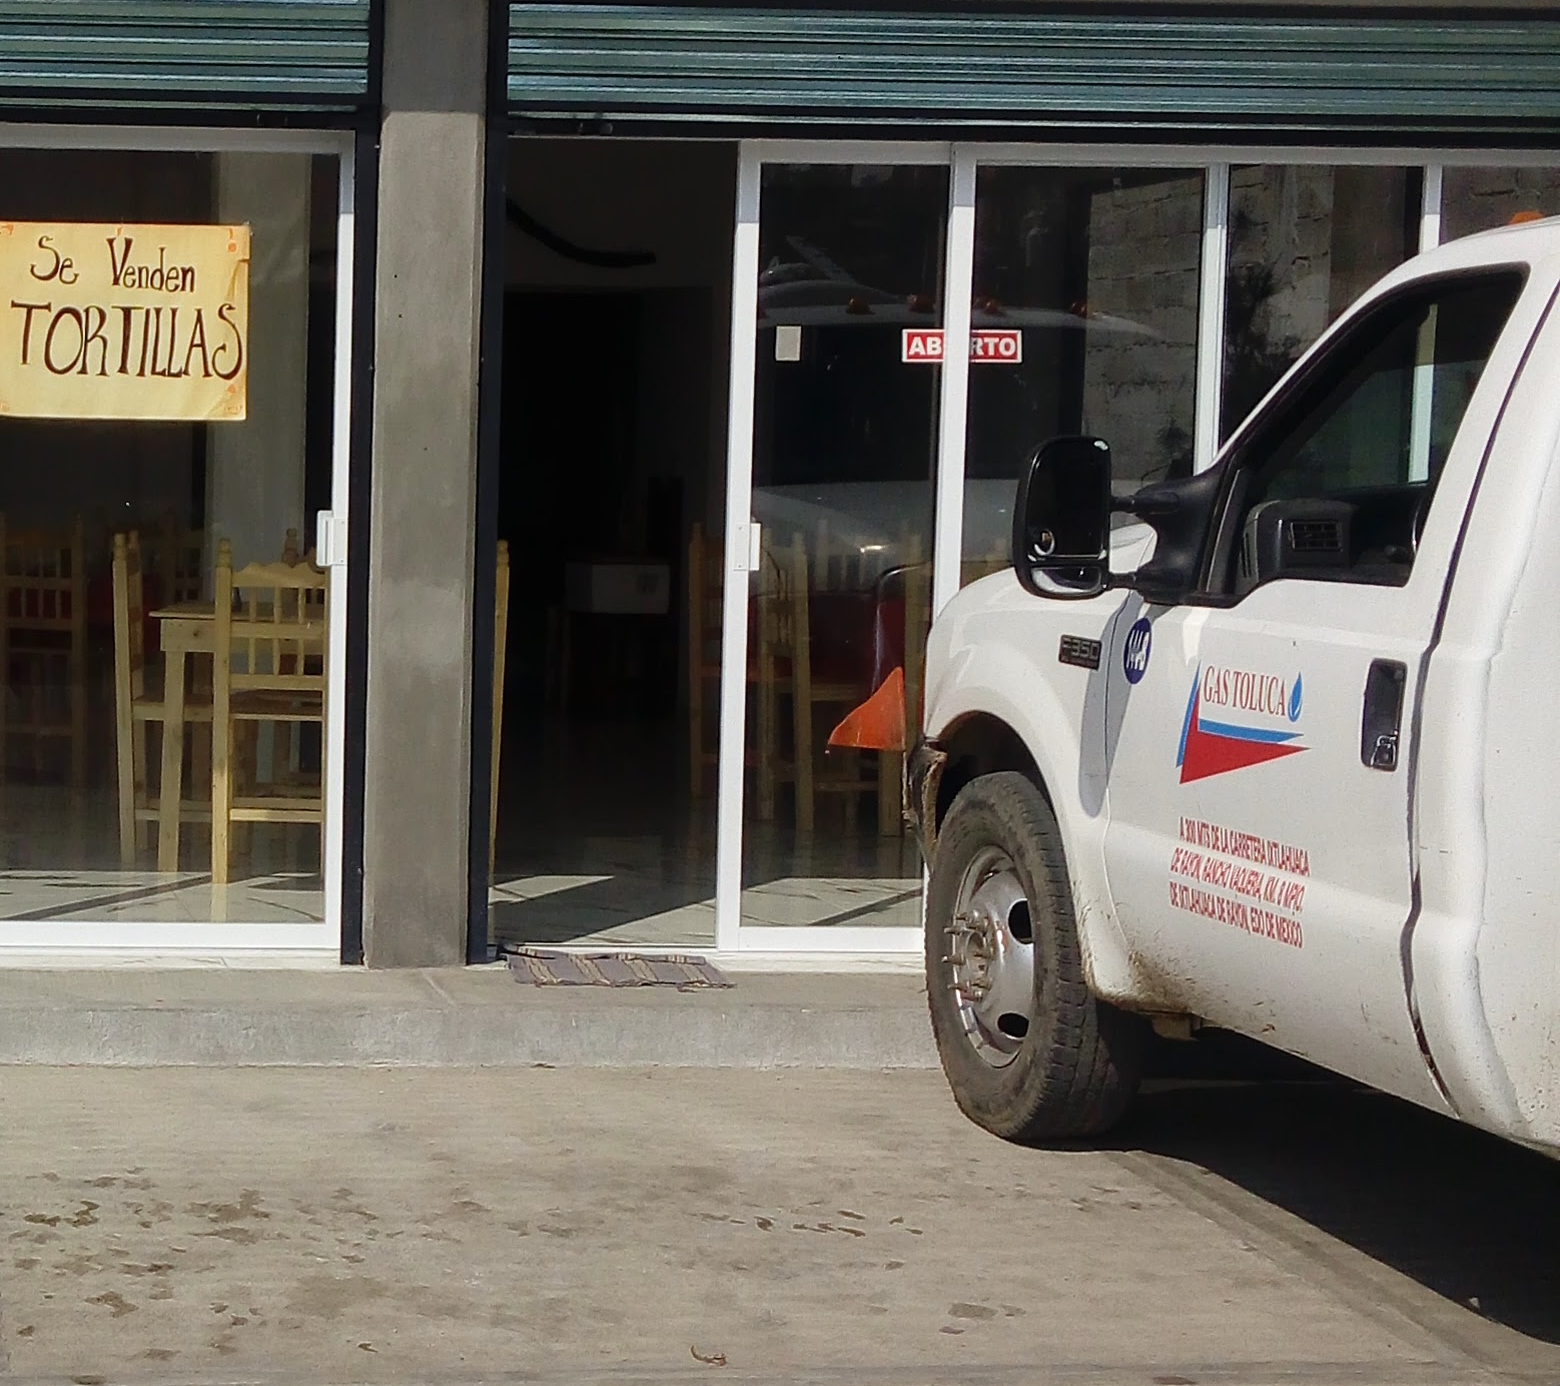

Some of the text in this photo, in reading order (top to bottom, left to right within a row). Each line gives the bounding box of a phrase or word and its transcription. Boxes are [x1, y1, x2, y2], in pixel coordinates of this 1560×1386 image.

[30, 235, 195, 293] Se Venden
[11, 300, 242, 380] TORTILLAS
[908, 336, 1016, 356] ABRTO
[1203, 665, 1286, 716] GAS TOLUCA
